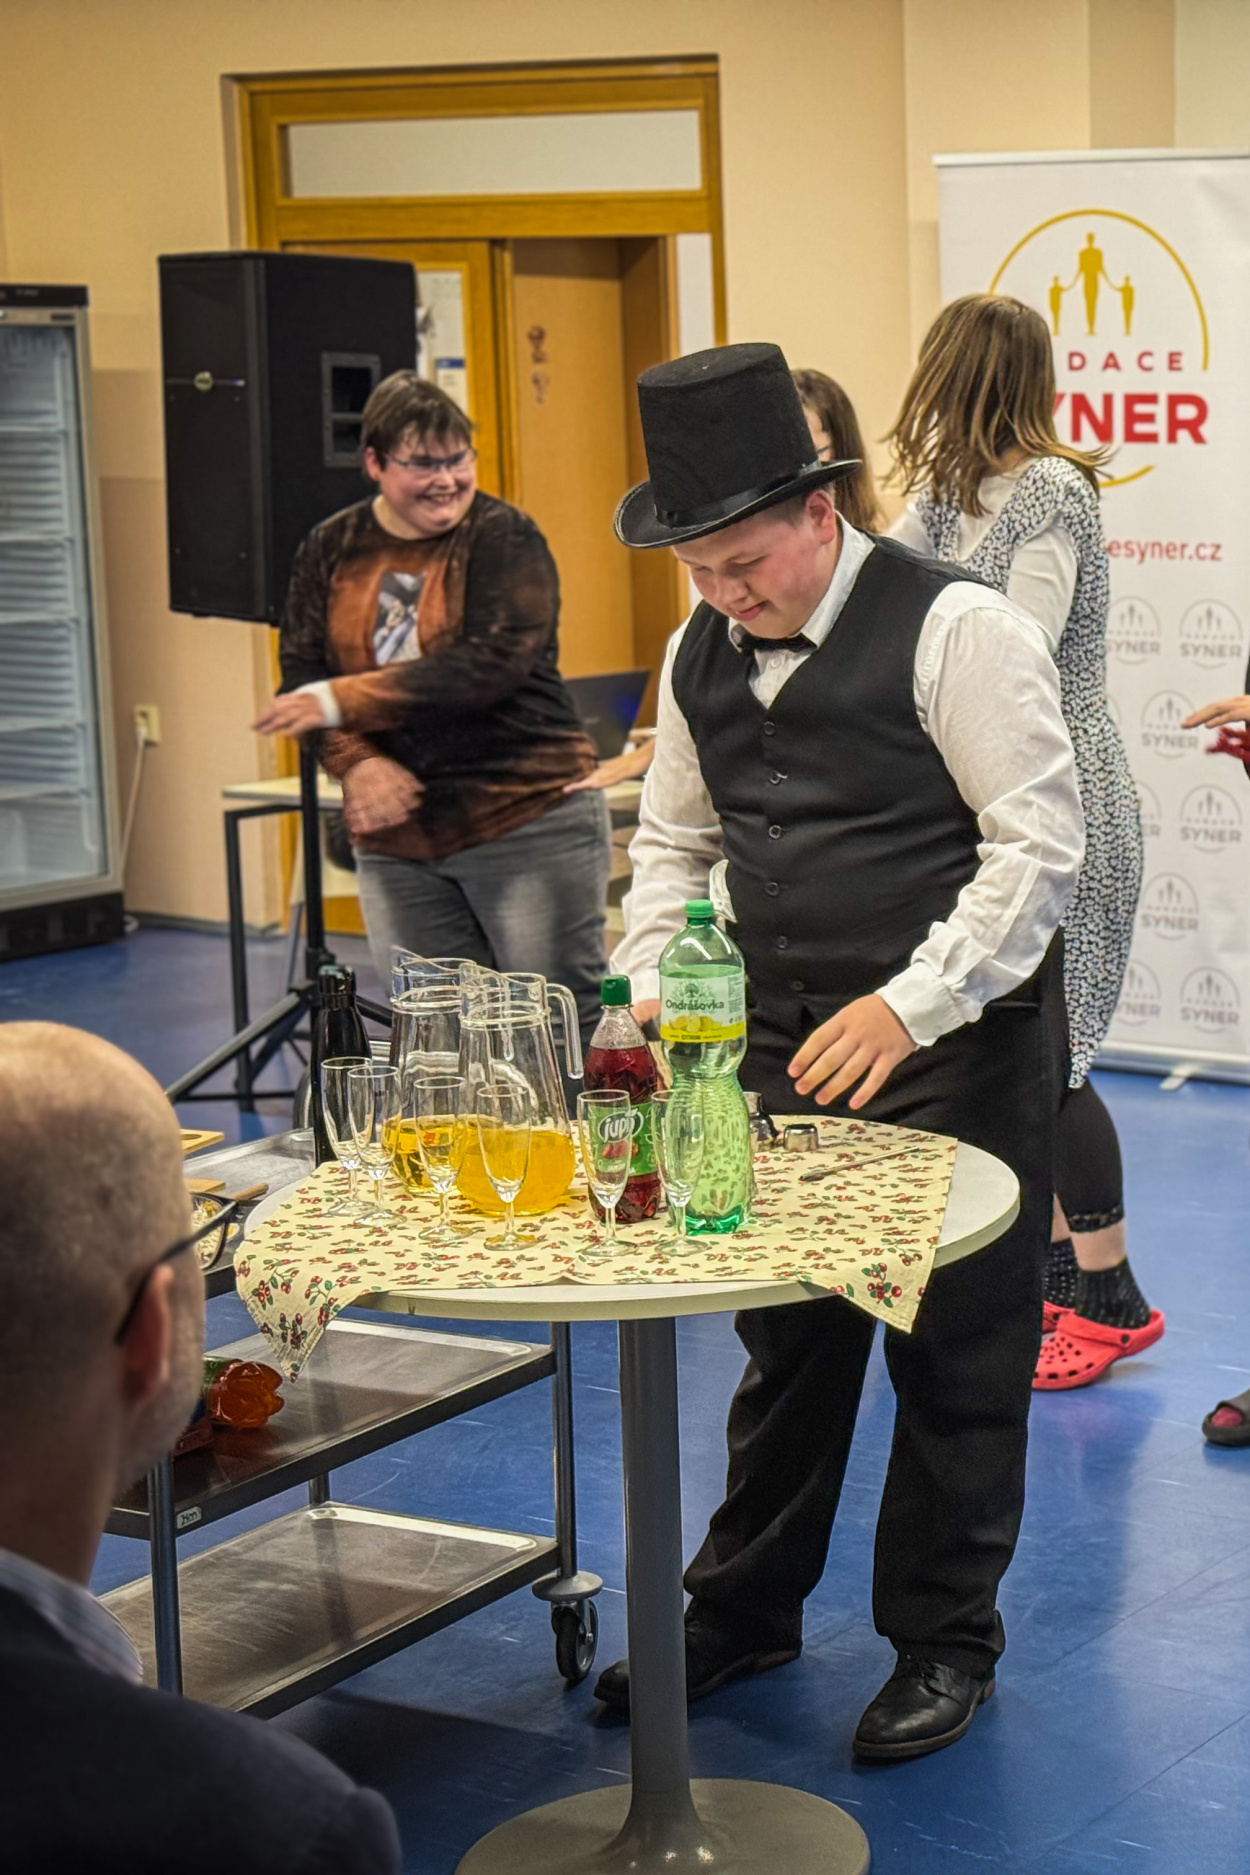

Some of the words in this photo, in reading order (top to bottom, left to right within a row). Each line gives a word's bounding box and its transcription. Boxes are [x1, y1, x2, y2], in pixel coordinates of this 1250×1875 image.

[1067, 351, 1183, 371] DACE
[1052, 392, 1208, 444] NER
[1106, 540, 1222, 564] esyner.cz
[1179, 643, 1242, 658] SYNER
[1141, 732, 1199, 749] SYNER
[1179, 826, 1242, 843] SYNER
[1141, 914, 1199, 932] SYNER
[1180, 1006, 1241, 1025] SYNER
